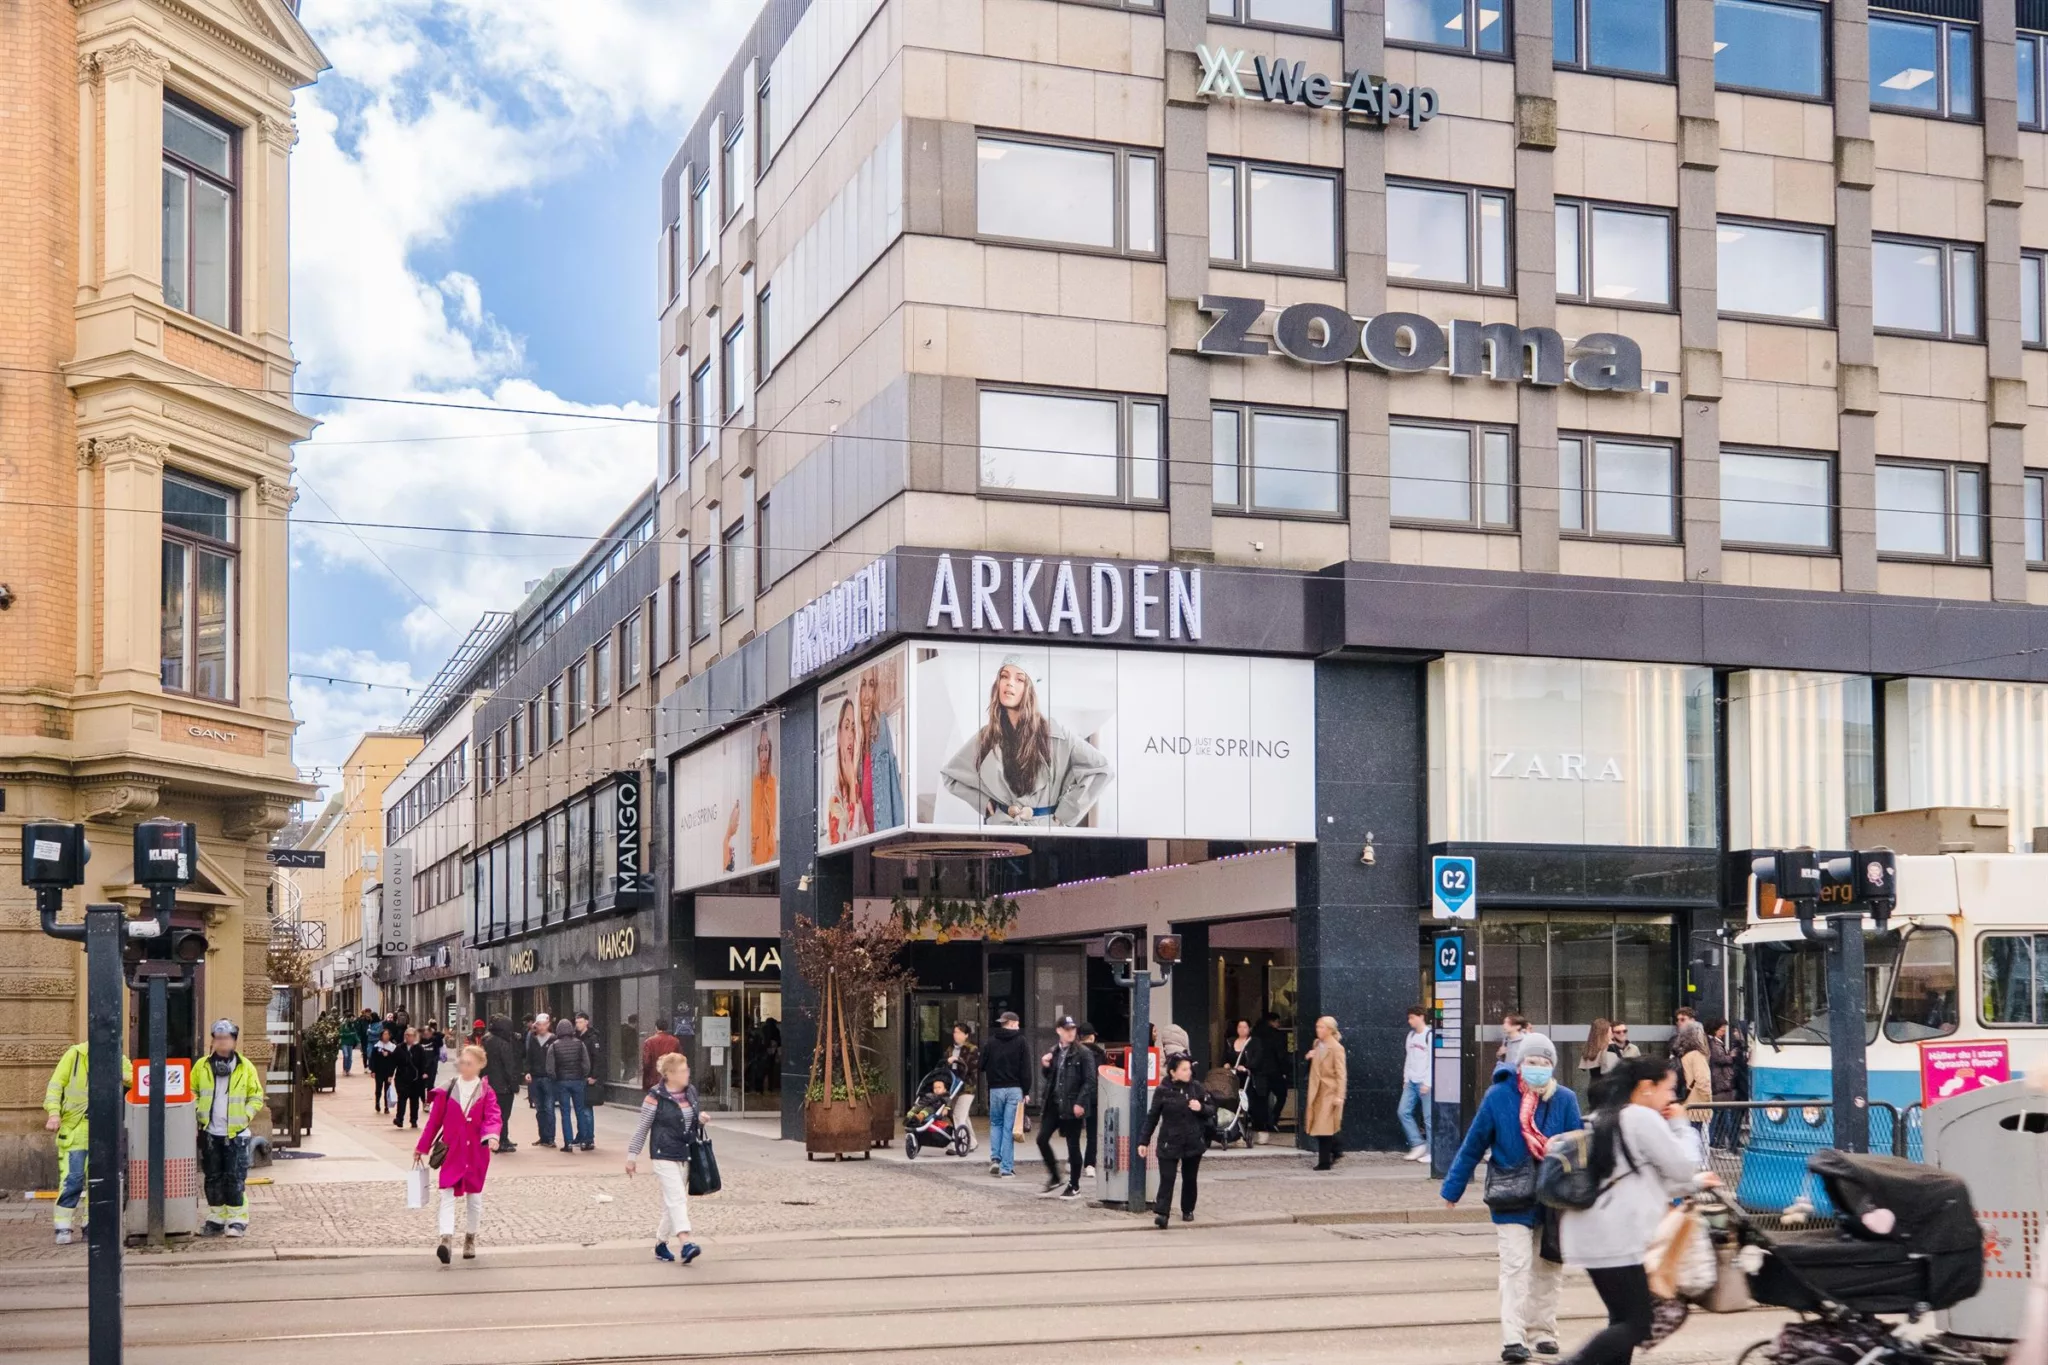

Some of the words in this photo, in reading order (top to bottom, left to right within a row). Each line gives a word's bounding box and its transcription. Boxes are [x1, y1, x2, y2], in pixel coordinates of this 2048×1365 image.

[1254, 55, 1332, 109] We
[1344, 68, 1439, 129] App
[1197, 295, 1669, 394] zooma.
[927, 553, 1201, 640] ARKADEN
[791, 559, 887, 679] ARKADEN
[188, 726, 238, 741] GANT
[1144, 736, 1192, 755] AND
[1215, 738, 1290, 759] SPRING
[1194, 737, 1212, 747] JUST
[1195, 747, 1212, 756] LIKE
[1490, 753, 1626, 783] ZARA
[619, 783, 638, 893] MANGO
[266, 851, 320, 865] GANT
[393, 853, 402, 885] ONLY
[1442, 870, 1466, 889] C2
[393, 889, 402, 937] DESIGN
[598, 927, 634, 961] MANGO
[1441, 948, 1457, 967] C2
[510, 949, 534, 976] MANGO
